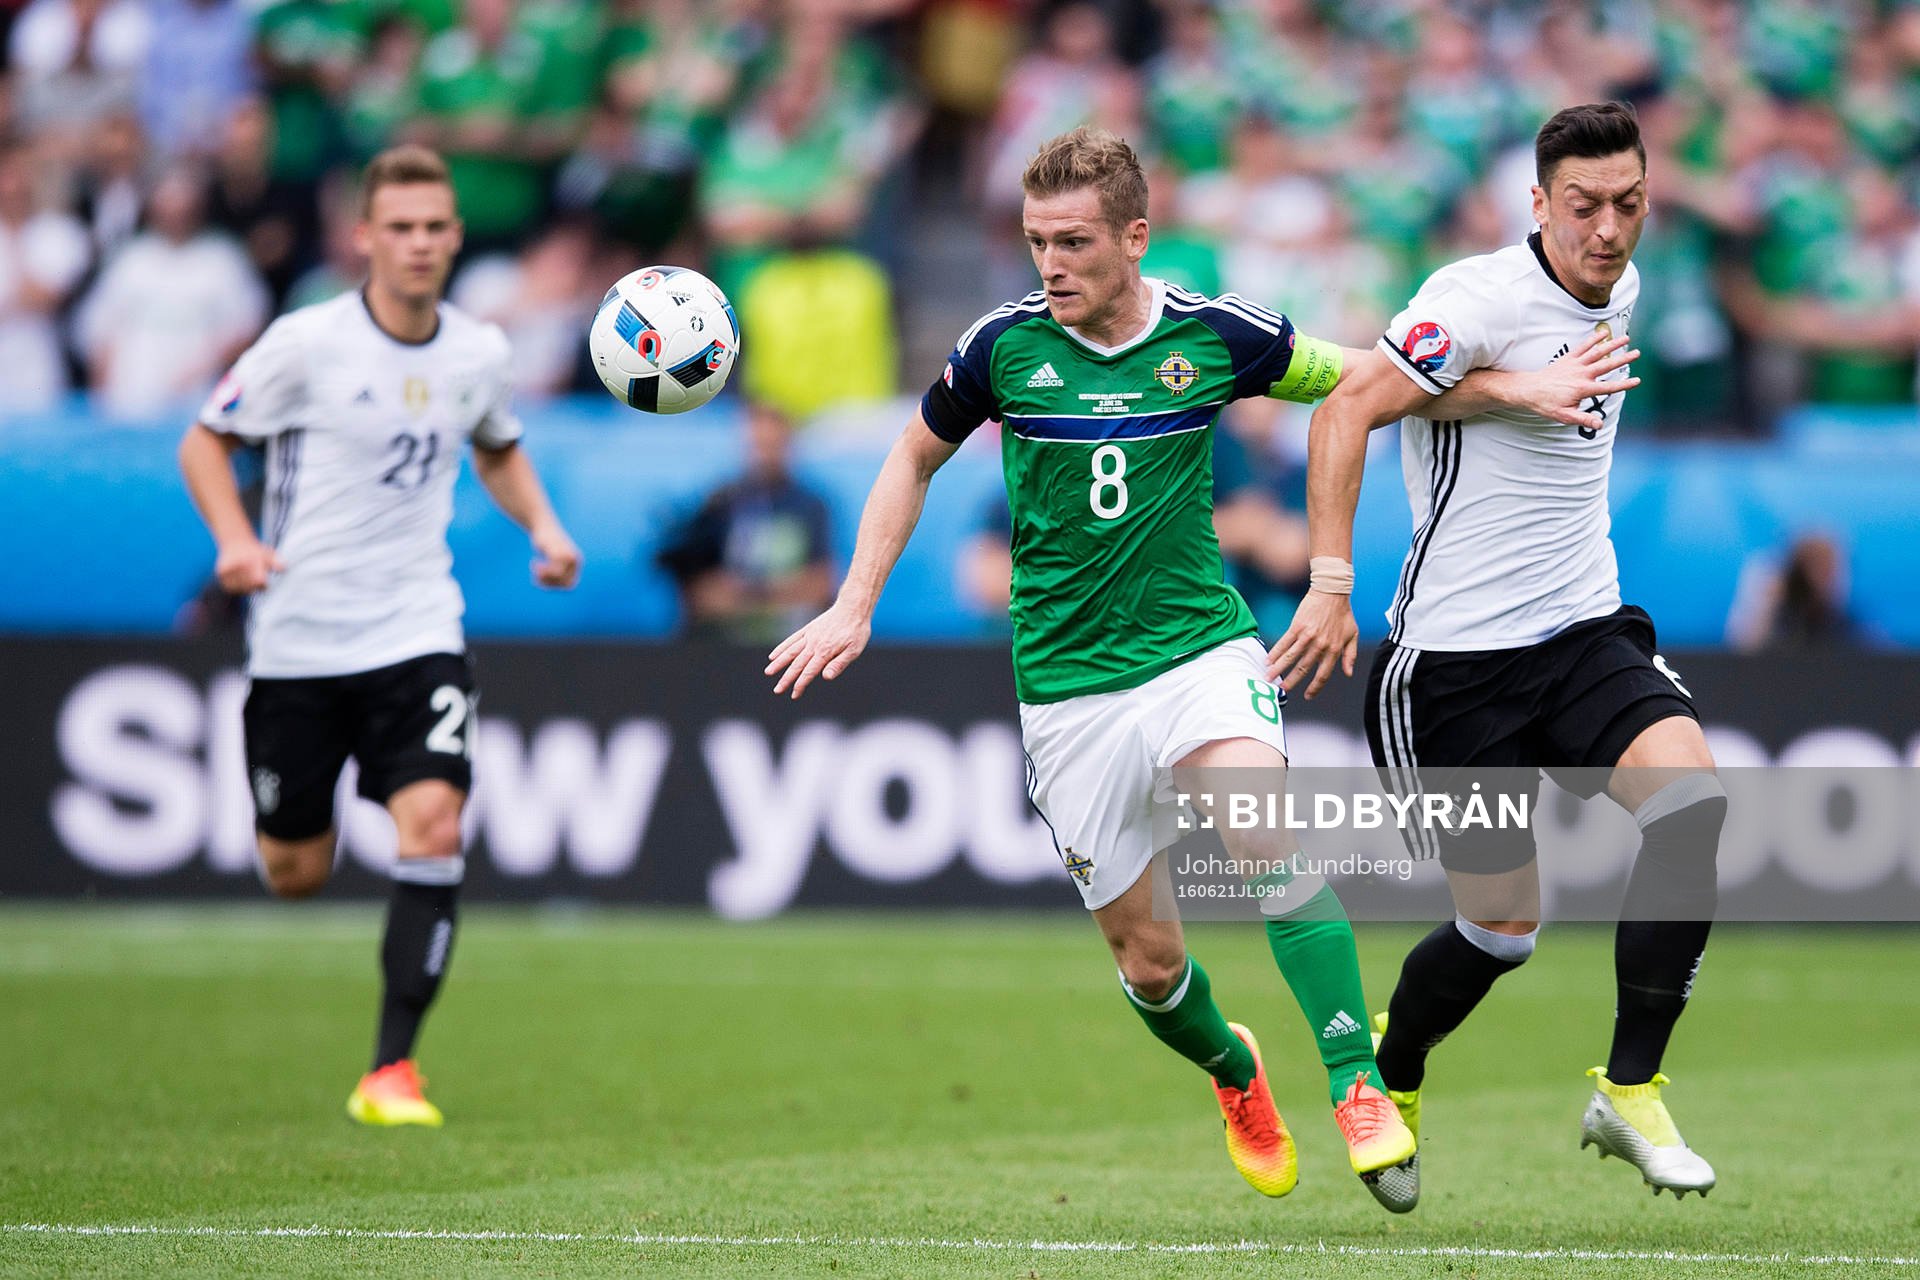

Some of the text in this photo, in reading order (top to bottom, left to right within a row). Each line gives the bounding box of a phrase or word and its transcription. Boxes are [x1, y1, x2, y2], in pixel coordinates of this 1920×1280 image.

[1027, 377, 1064, 387] adidas
[1313, 356, 1333, 393] RESPECT
[380, 431, 438, 489] 21
[1089, 444, 1129, 520] 8
[1247, 678, 1279, 725] 8
[1322, 1022, 1362, 1038] adidas
